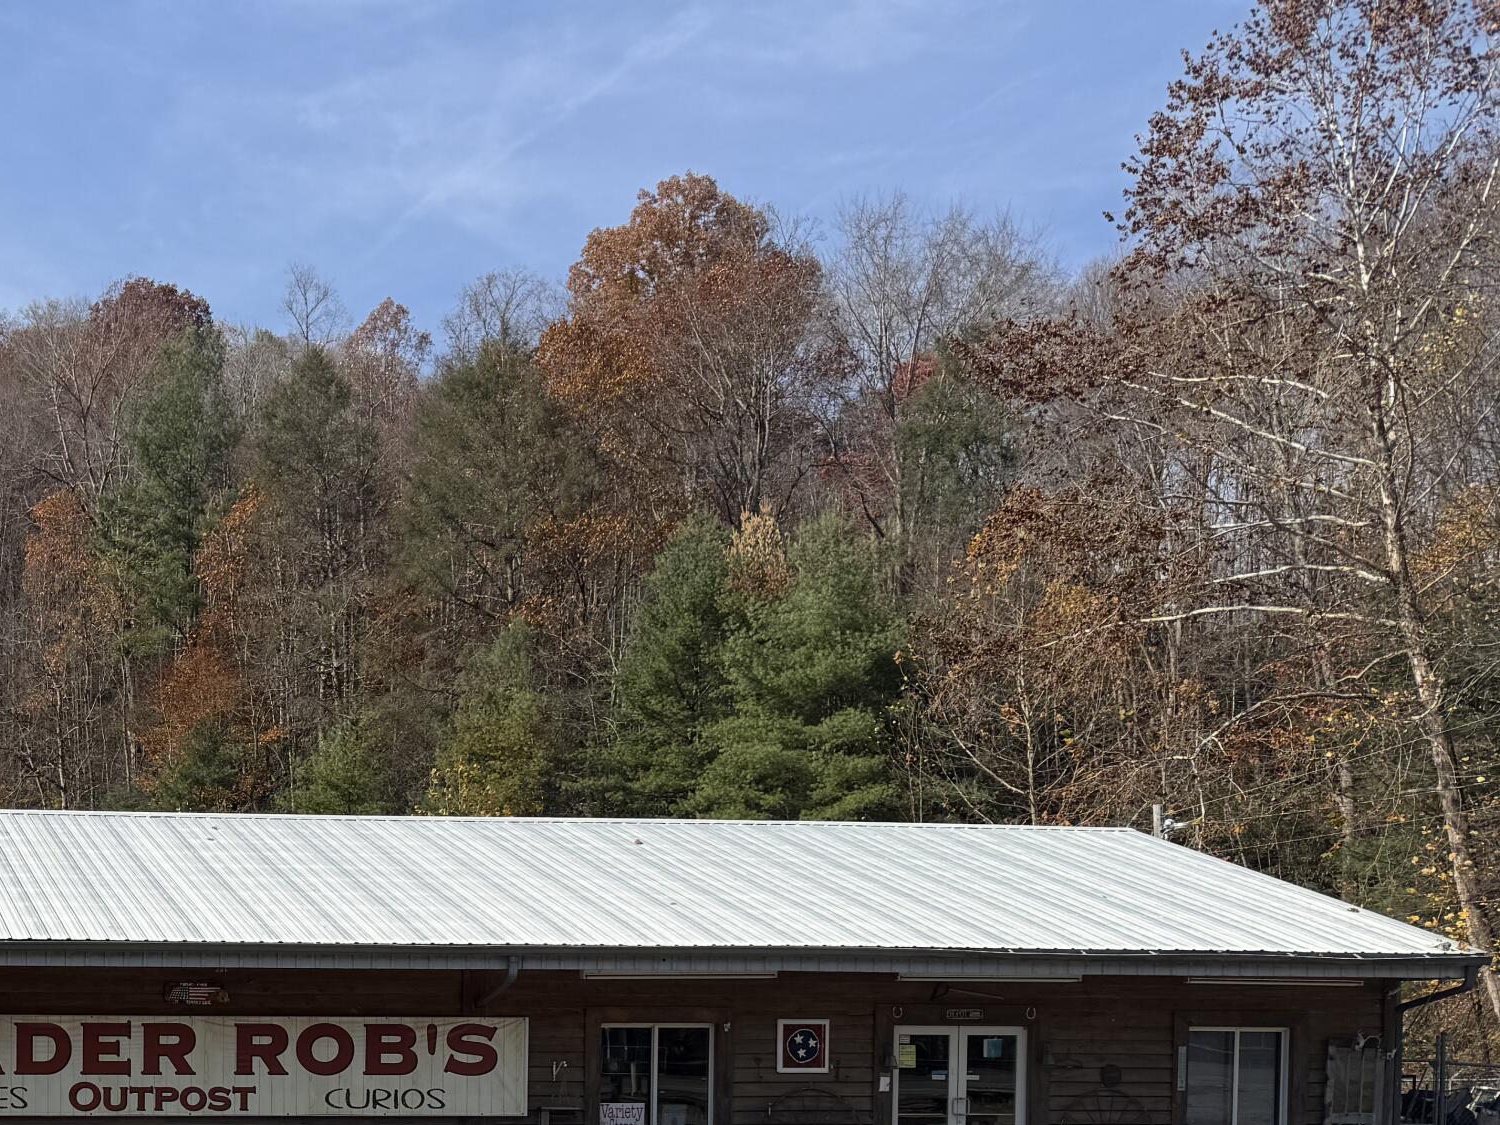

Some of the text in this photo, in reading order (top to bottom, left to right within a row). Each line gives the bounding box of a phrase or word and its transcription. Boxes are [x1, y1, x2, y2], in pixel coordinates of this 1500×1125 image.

[234, 1022, 499, 1076] ROB'S
[70, 1083, 256, 1112] OUTPOST
[326, 1088, 446, 1110] CURIOS
[601, 1104, 644, 1121] Variety
